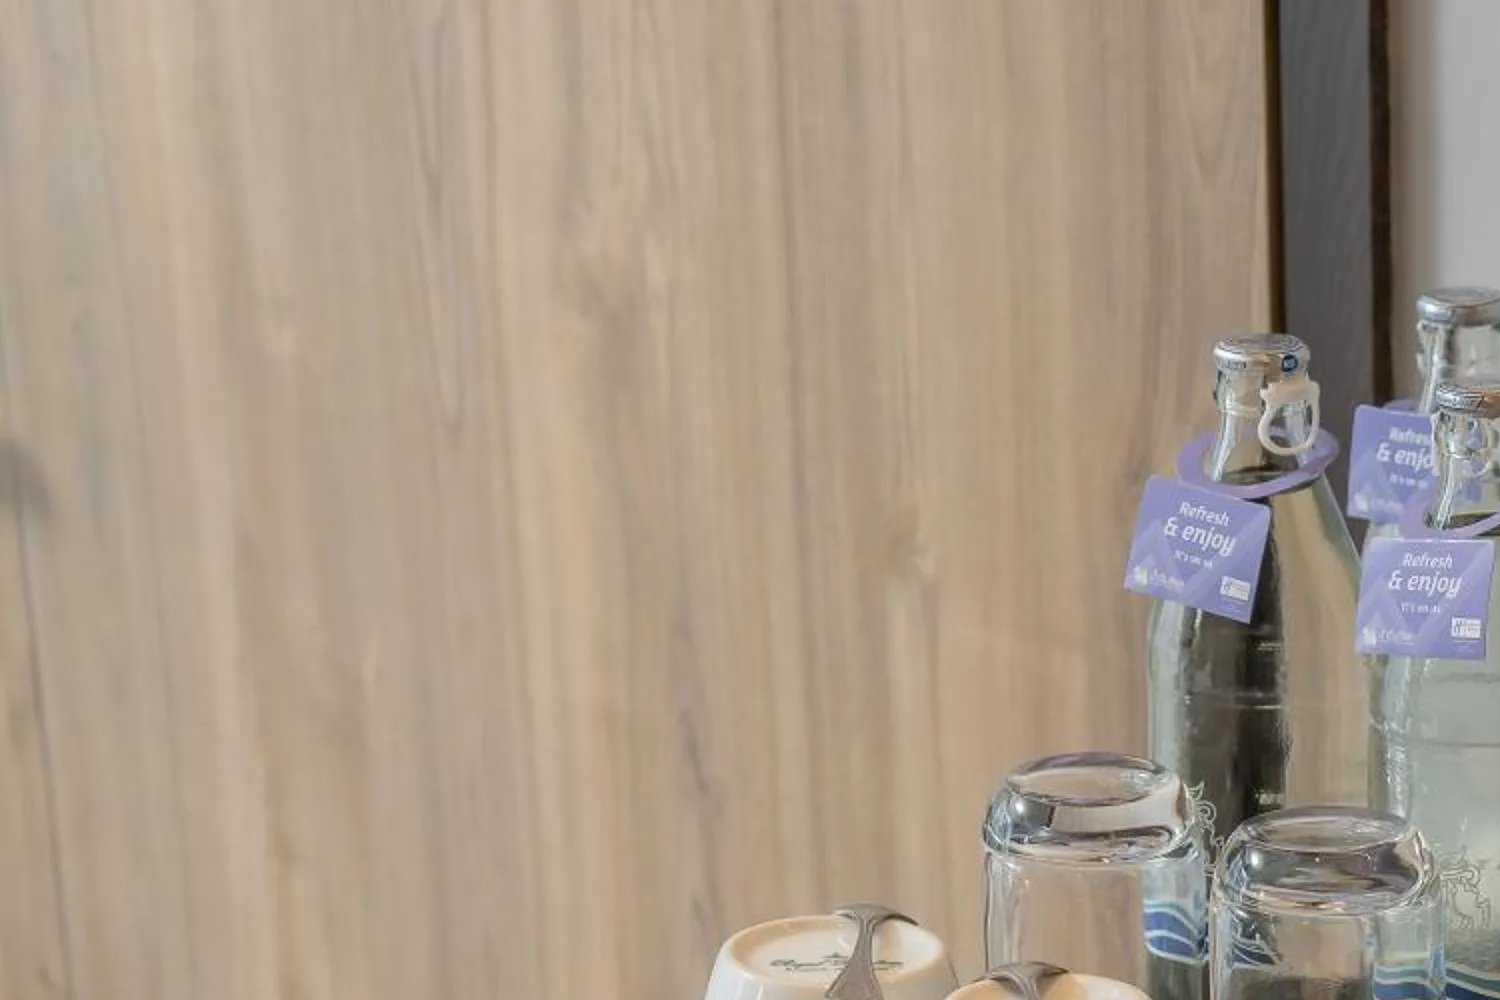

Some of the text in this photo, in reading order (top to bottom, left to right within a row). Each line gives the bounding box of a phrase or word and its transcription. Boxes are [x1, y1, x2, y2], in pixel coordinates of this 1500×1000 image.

[1377, 442, 1434, 474] & enjo
[1179, 501, 1230, 527] Refresh
[1164, 516, 1237, 557] & enjoy
[1403, 552, 1453, 569] Refresh
[1388, 570, 1462, 599] & enjoy
